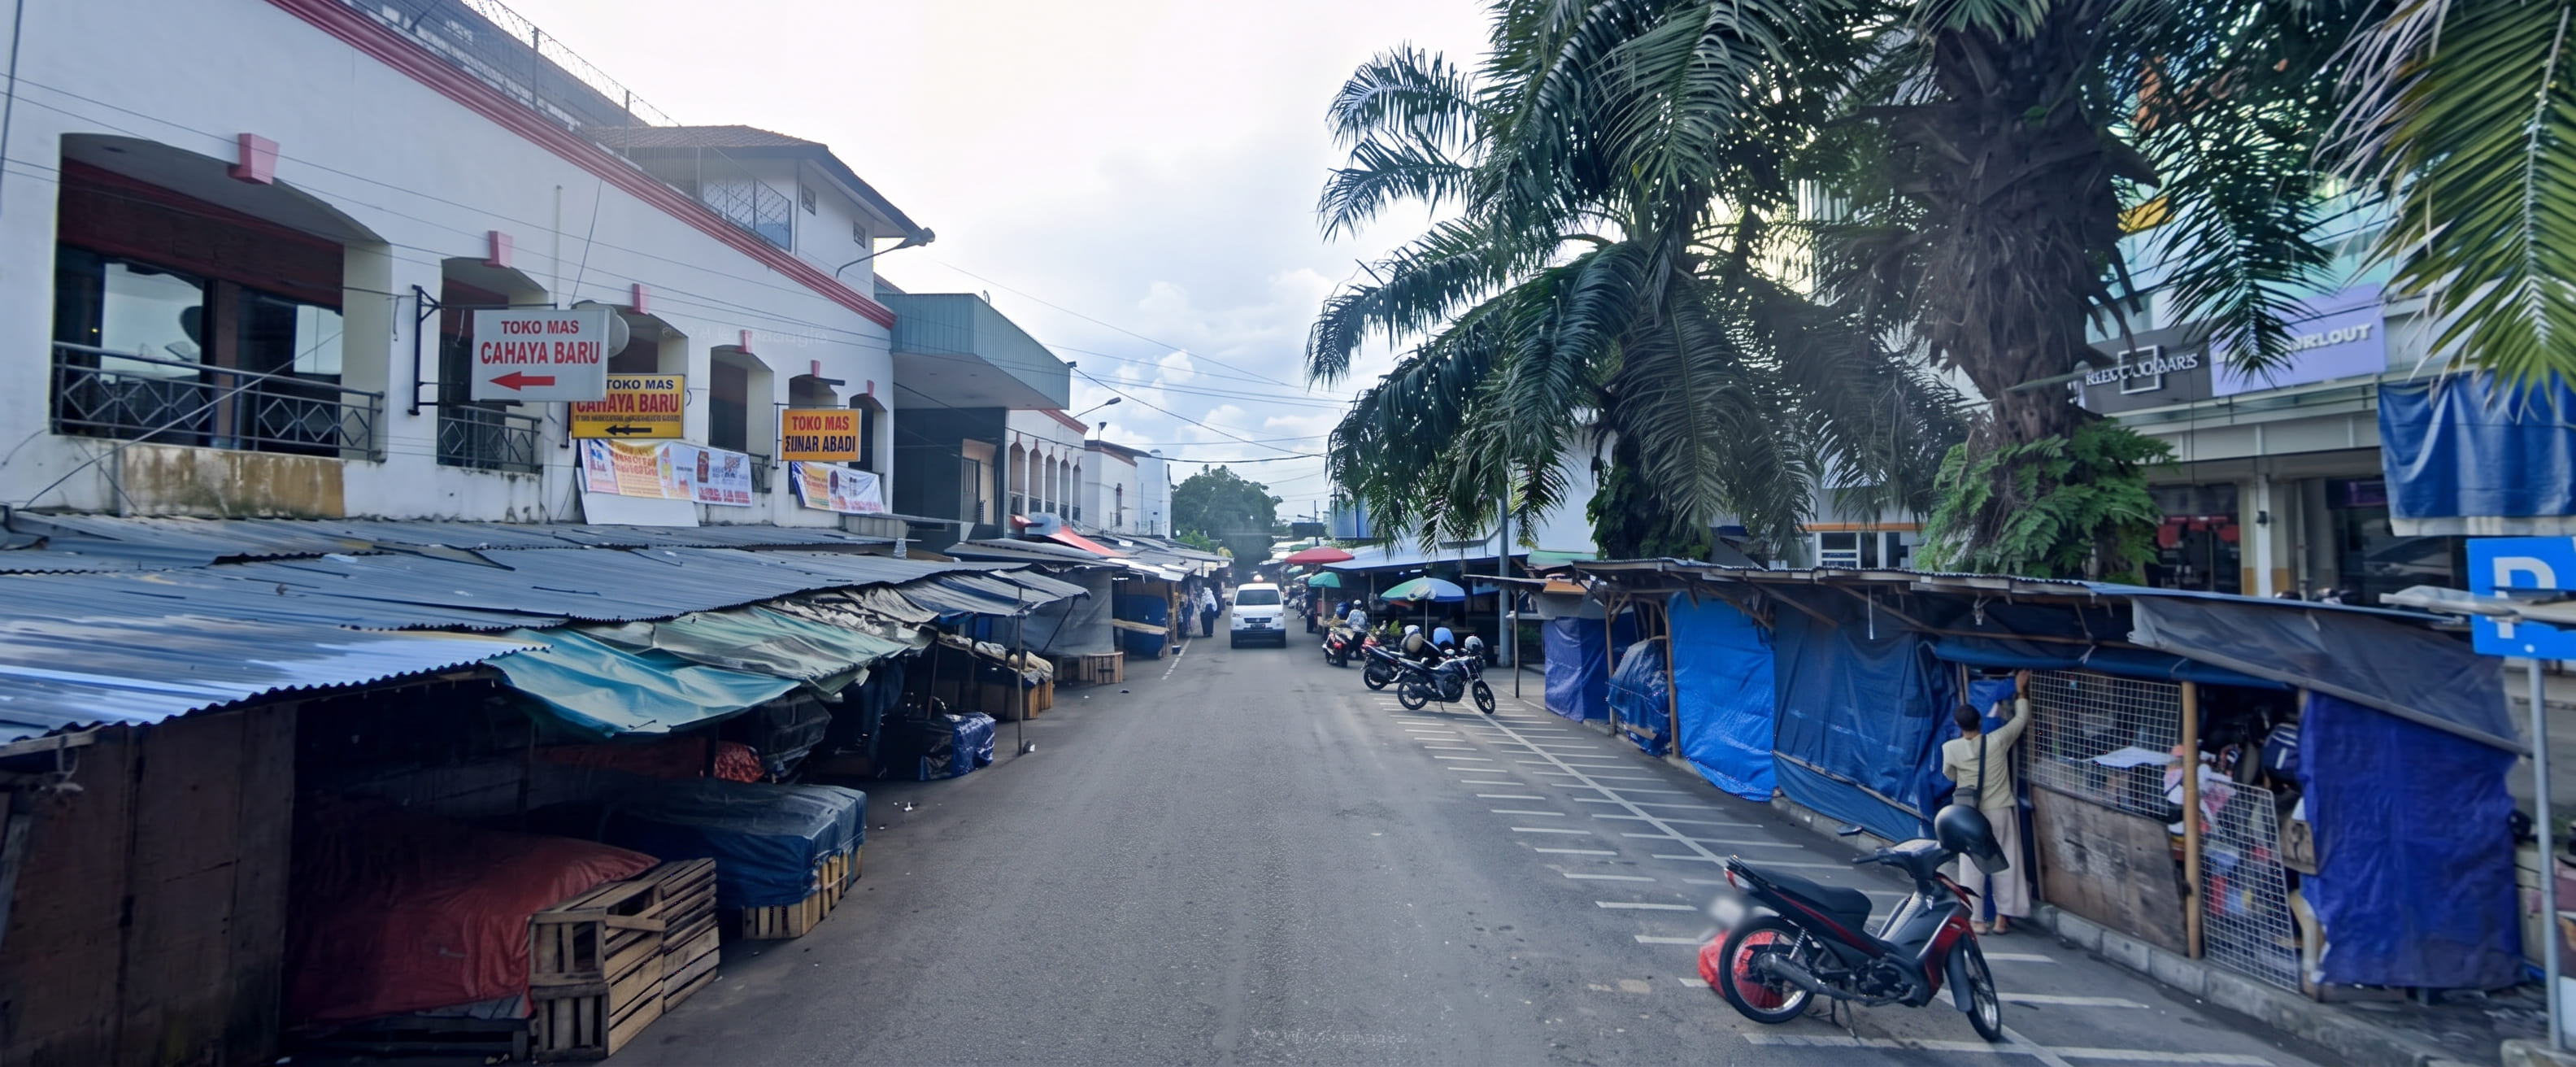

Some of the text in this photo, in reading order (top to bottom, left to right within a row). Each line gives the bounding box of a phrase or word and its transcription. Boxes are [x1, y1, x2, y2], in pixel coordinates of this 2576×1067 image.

[501, 320, 579, 334] TOKO MAS
[481, 342, 600, 364] CAHAYA BARU
[607, 380, 674, 390] TOKO MAS
[639, 394, 680, 412] BARU
[792, 416, 850, 431] TOKO MAS
[822, 436, 855, 452] ABADI
[2493, 556, 2557, 639] P
